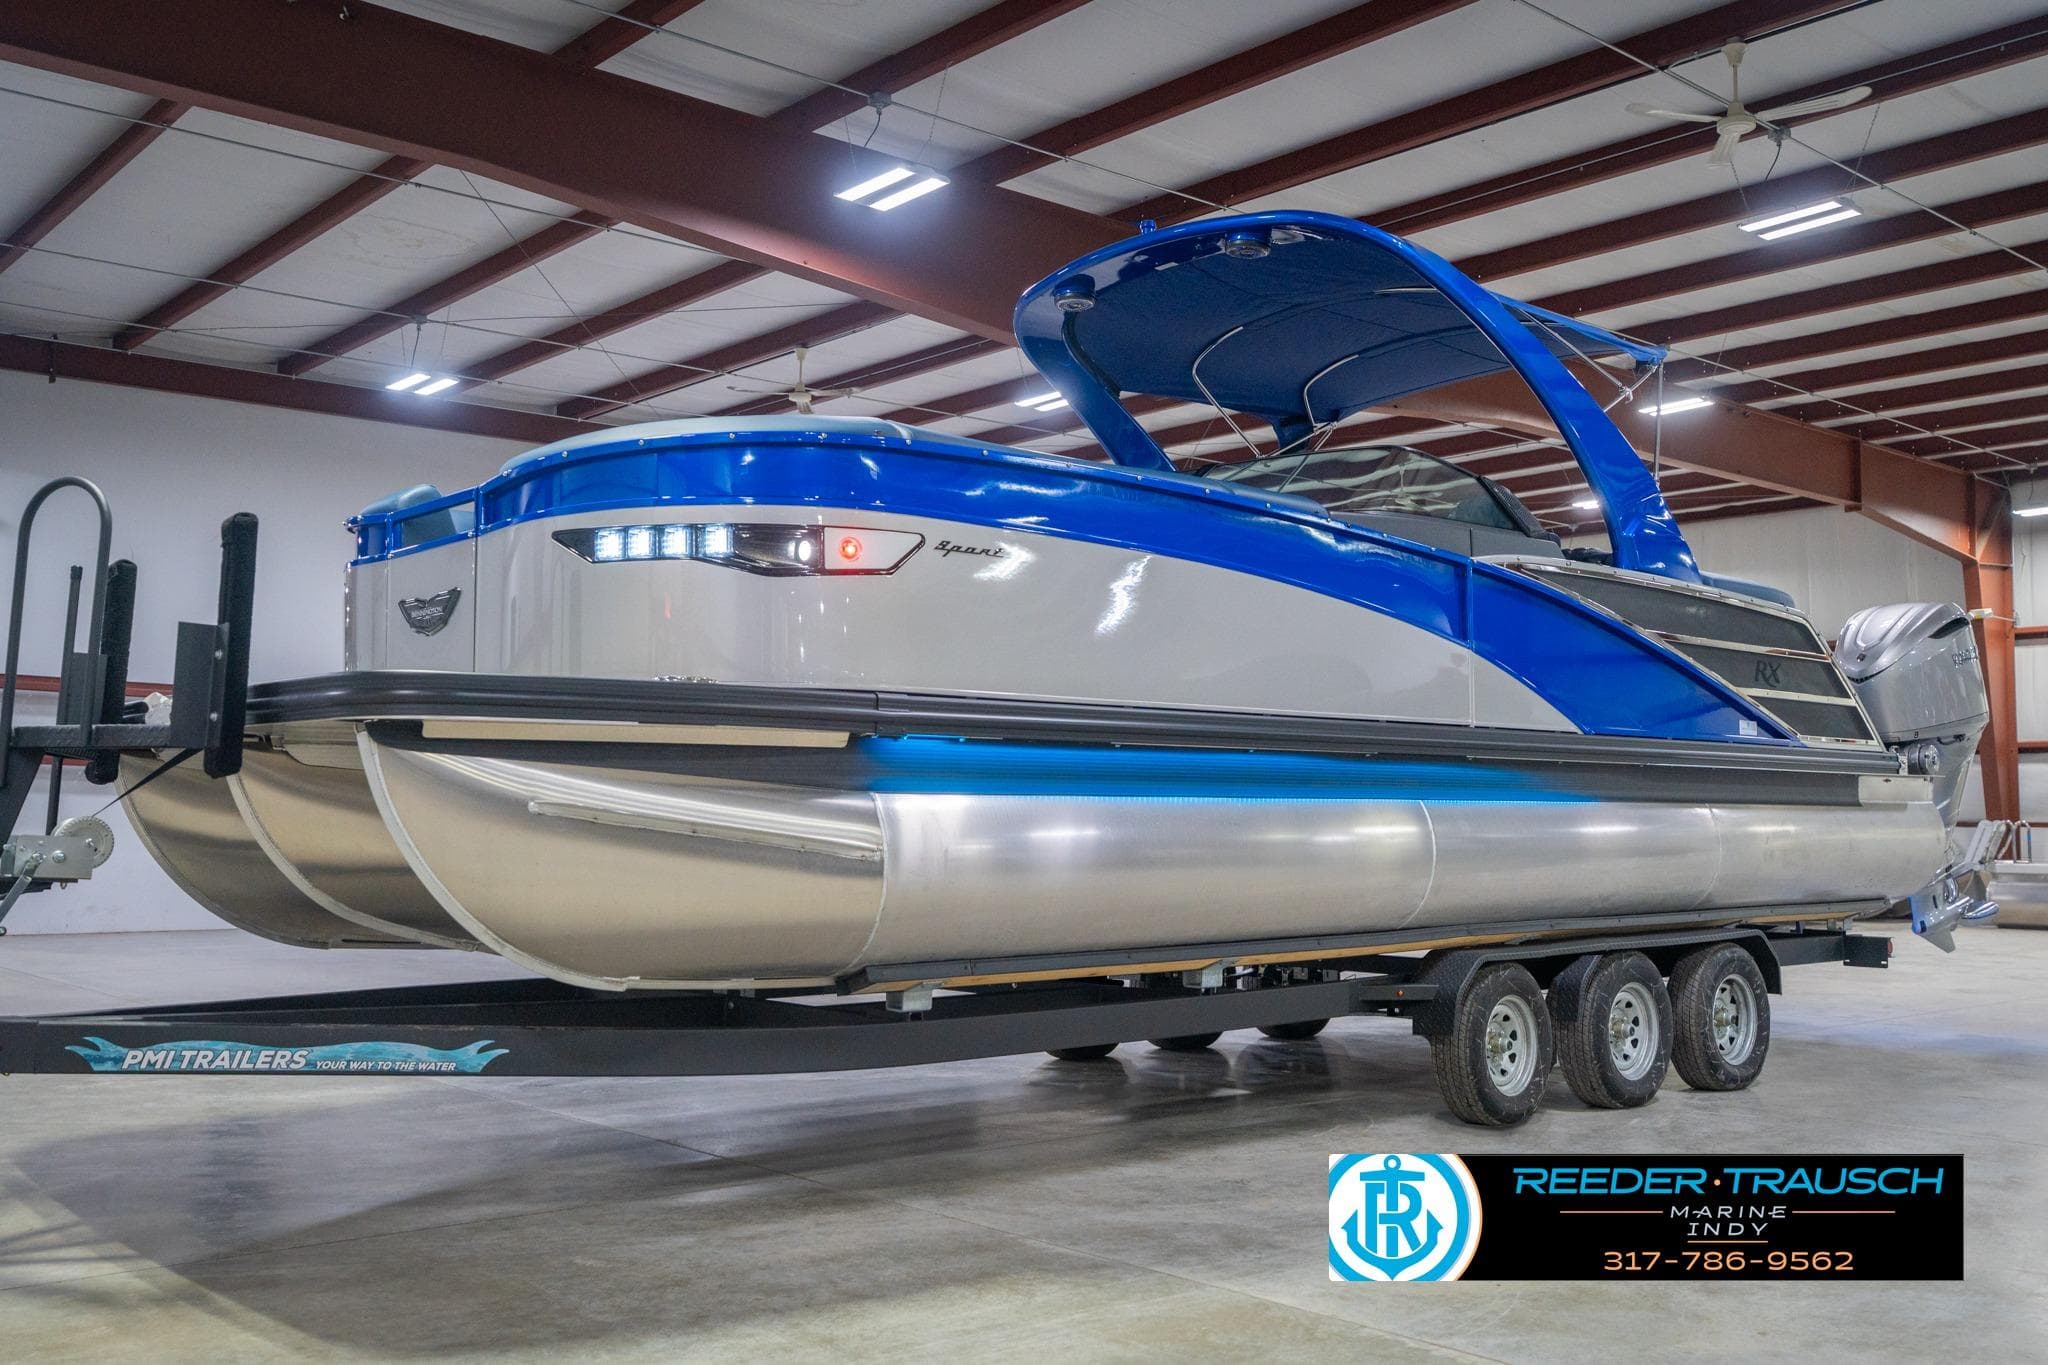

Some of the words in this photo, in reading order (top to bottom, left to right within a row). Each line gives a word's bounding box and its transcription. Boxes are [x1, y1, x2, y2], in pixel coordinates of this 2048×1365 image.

[934, 540, 1005, 558] Sport
[1754, 660, 1781, 688] RX
[121, 1049, 175, 1069] PMI
[180, 1049, 310, 1070] TRAILERS
[315, 1060, 347, 1070] YOUR
[350, 1060, 375, 1071] WAY
[377, 1061, 393, 1071] TO
[394, 1061, 417, 1071] THE
[418, 1062, 456, 1072] WATER
